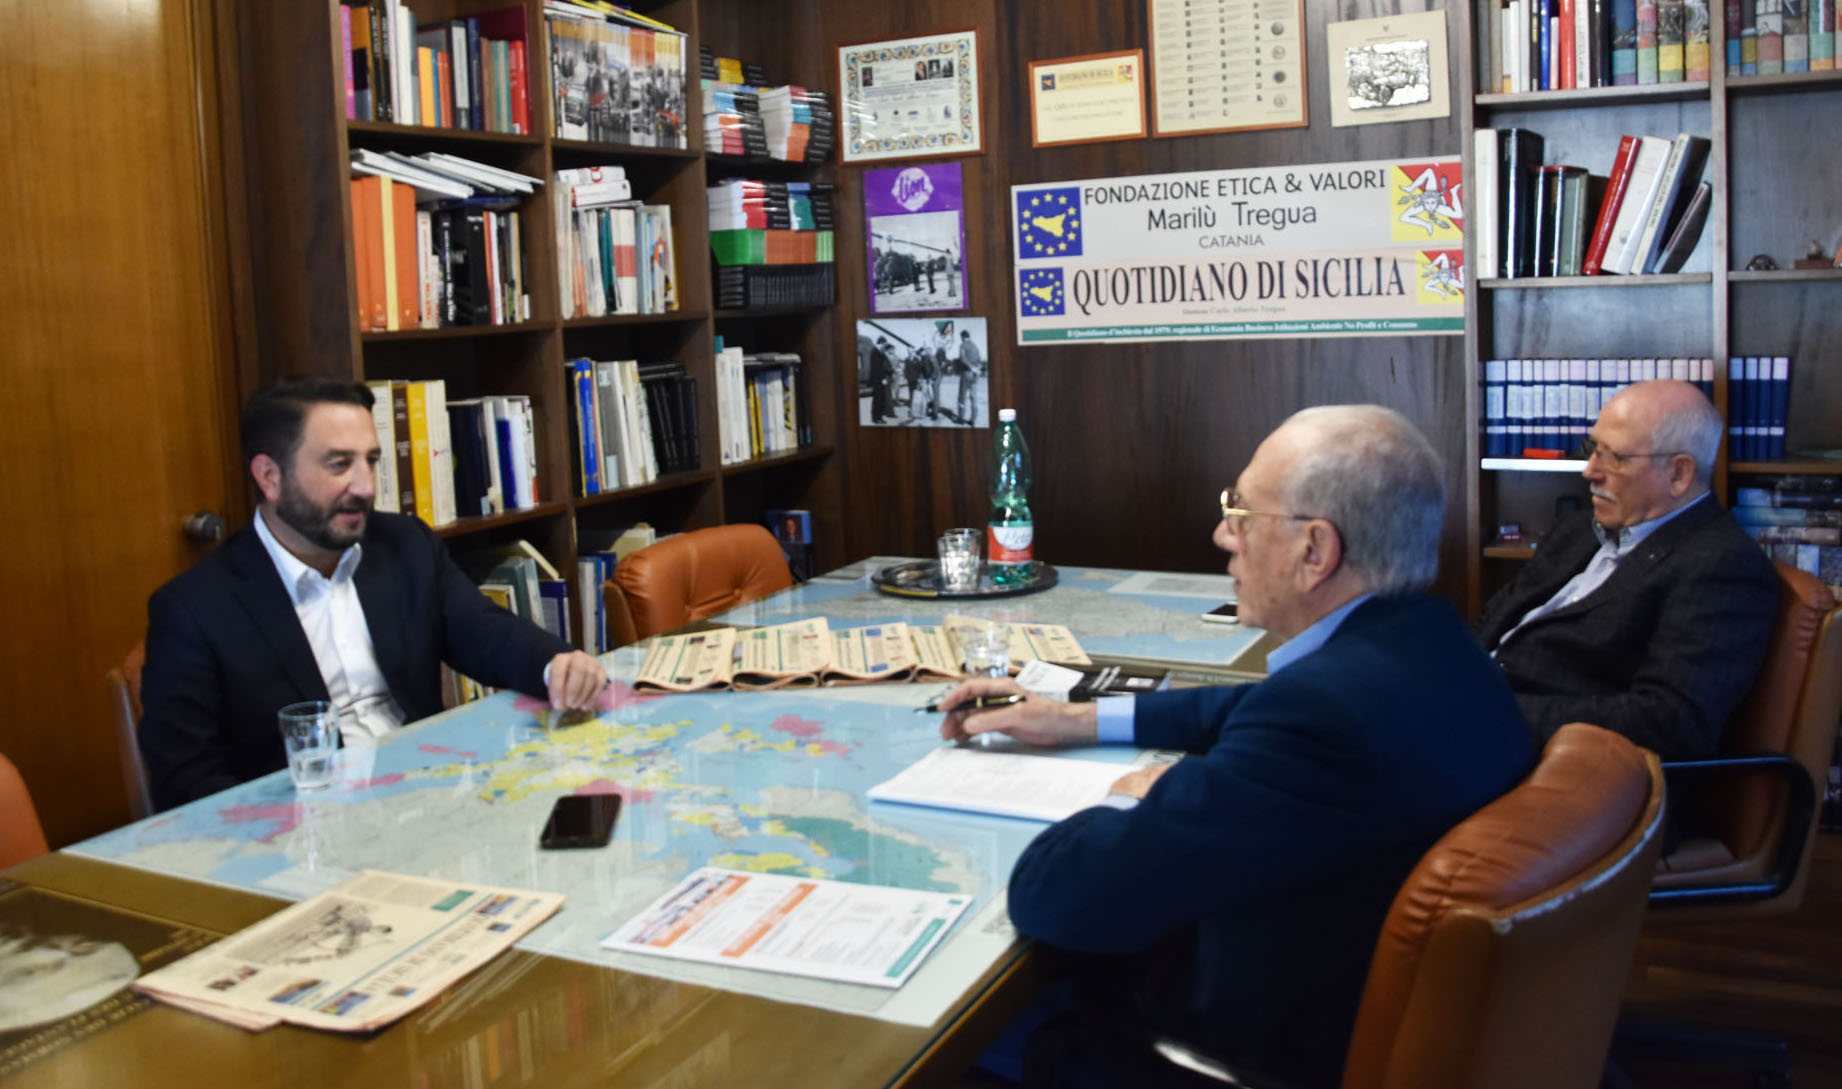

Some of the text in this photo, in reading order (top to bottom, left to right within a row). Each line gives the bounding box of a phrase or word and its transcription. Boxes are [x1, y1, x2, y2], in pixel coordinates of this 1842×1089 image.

[1084, 169, 1386, 205] FONDAZIONE ETICA & VALORI
[1147, 201, 1317, 231] Marilù Tregua
[1198, 234, 1265, 249] CATANIA
[1073, 256, 1406, 316] QUOTIDIANO DI SICILIA
